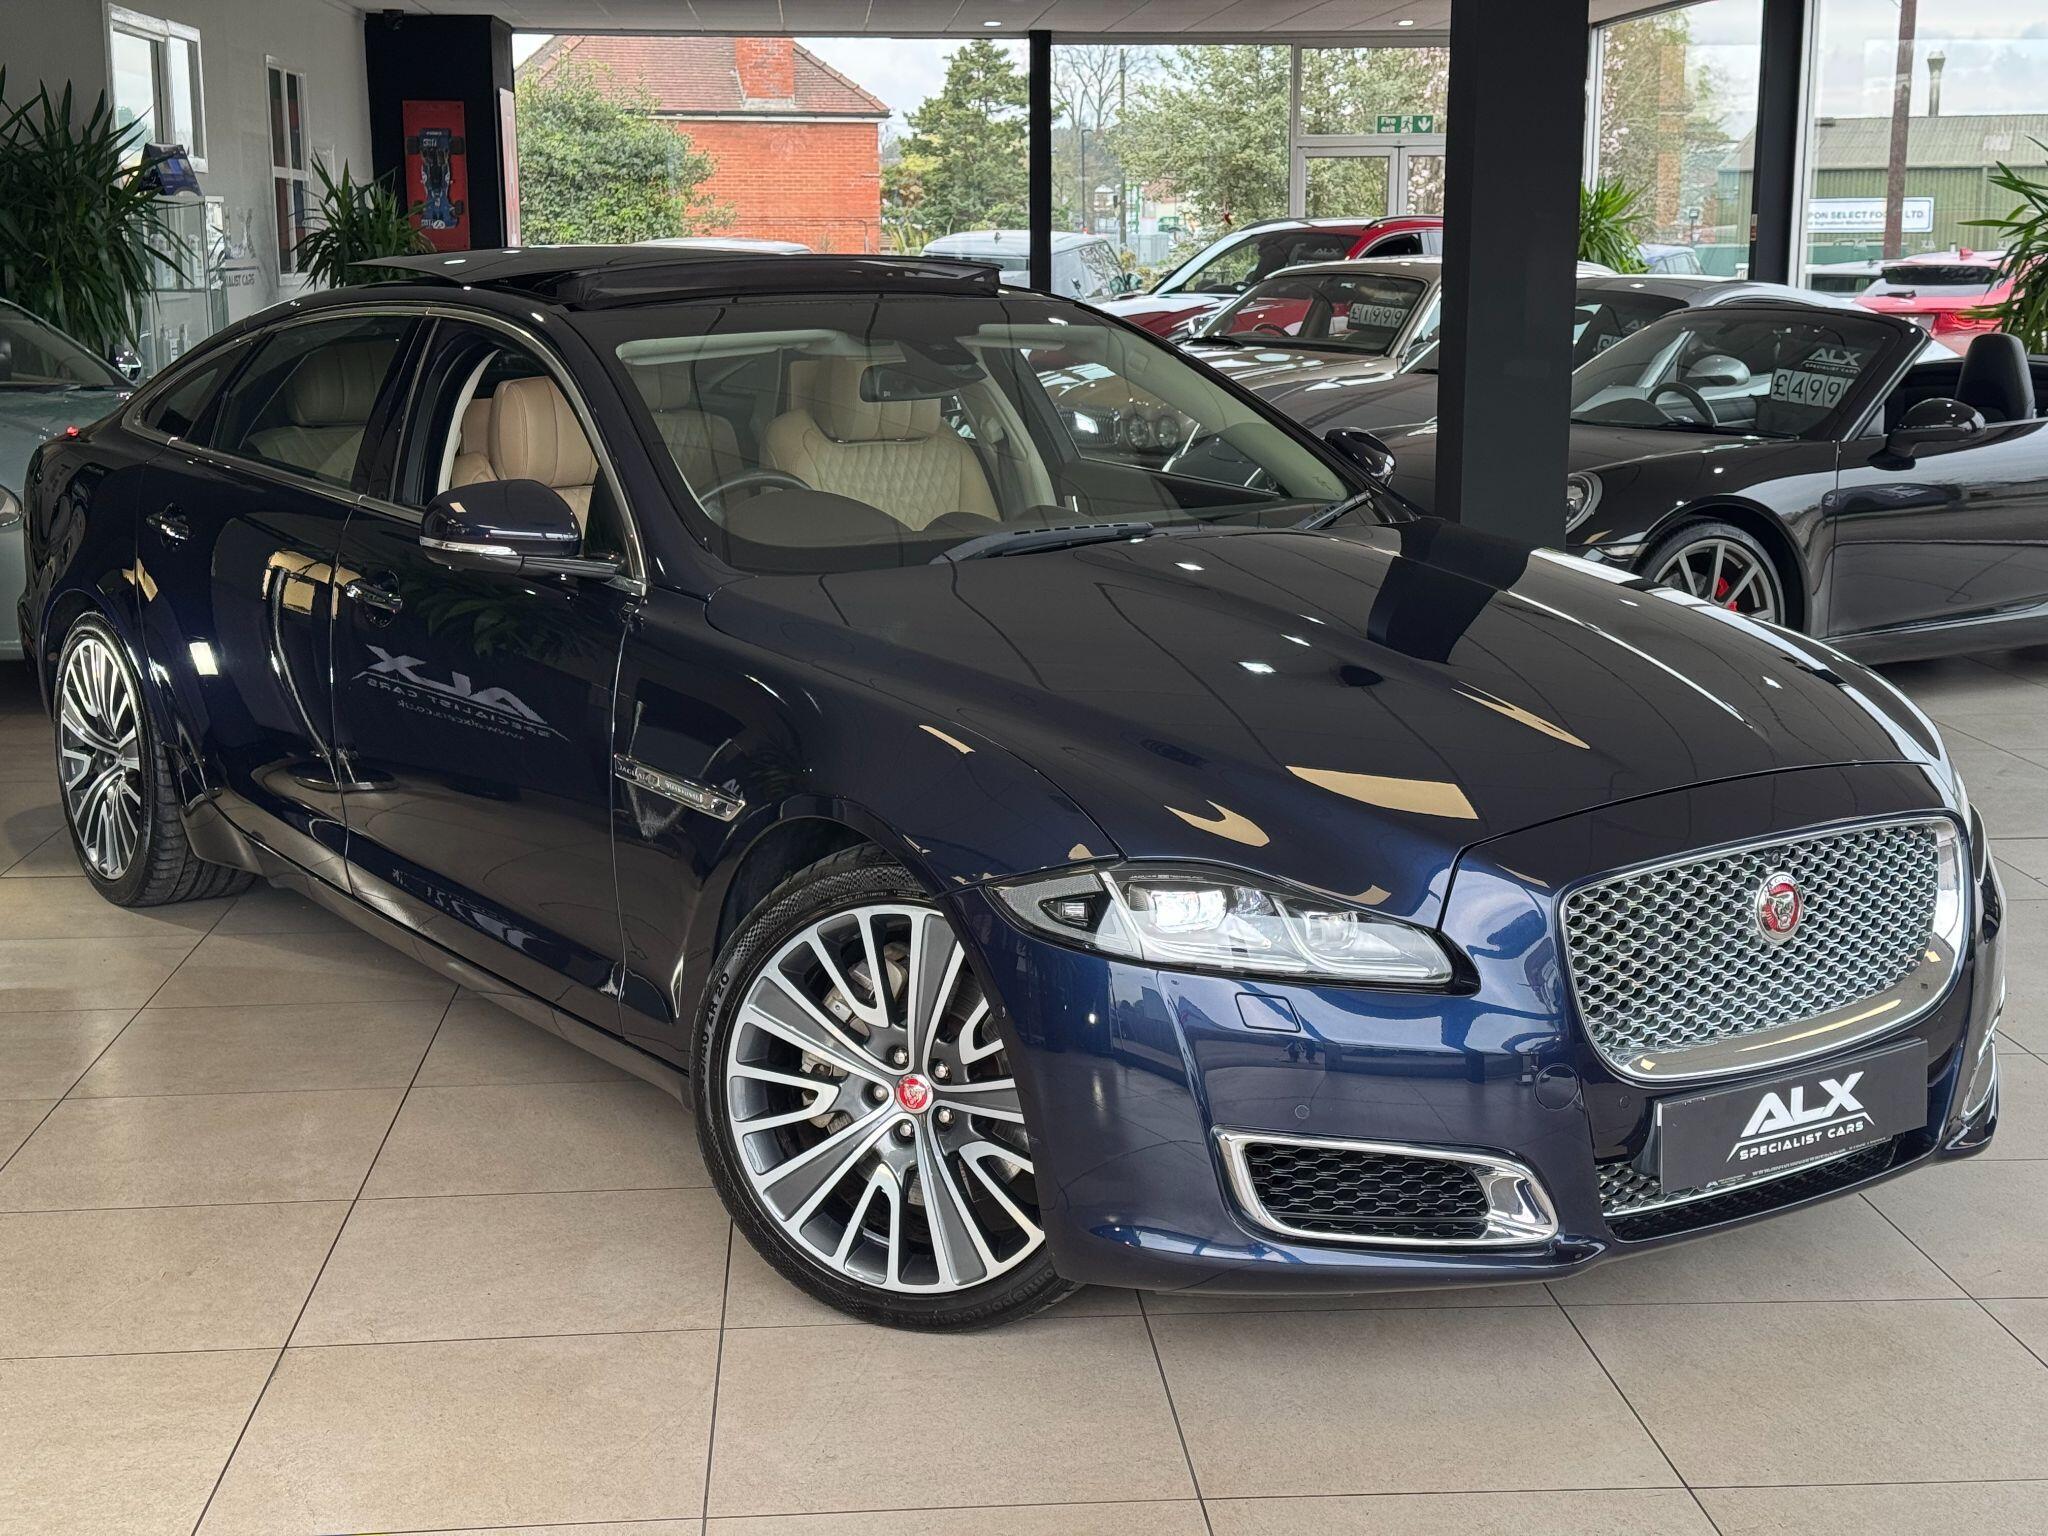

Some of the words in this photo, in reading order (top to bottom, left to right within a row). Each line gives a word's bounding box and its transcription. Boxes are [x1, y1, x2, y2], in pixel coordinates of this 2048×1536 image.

[1830, 210, 1868, 219] SELECT
[1904, 210, 1925, 219] LTD
[1313, 247, 1341, 256] ALX
[1807, 347, 1862, 367] ALX
[1740, 1071, 1865, 1138] ALX
[1739, 1131, 1823, 1162] SPECIALIST
[1828, 1121, 1865, 1140] CARS
